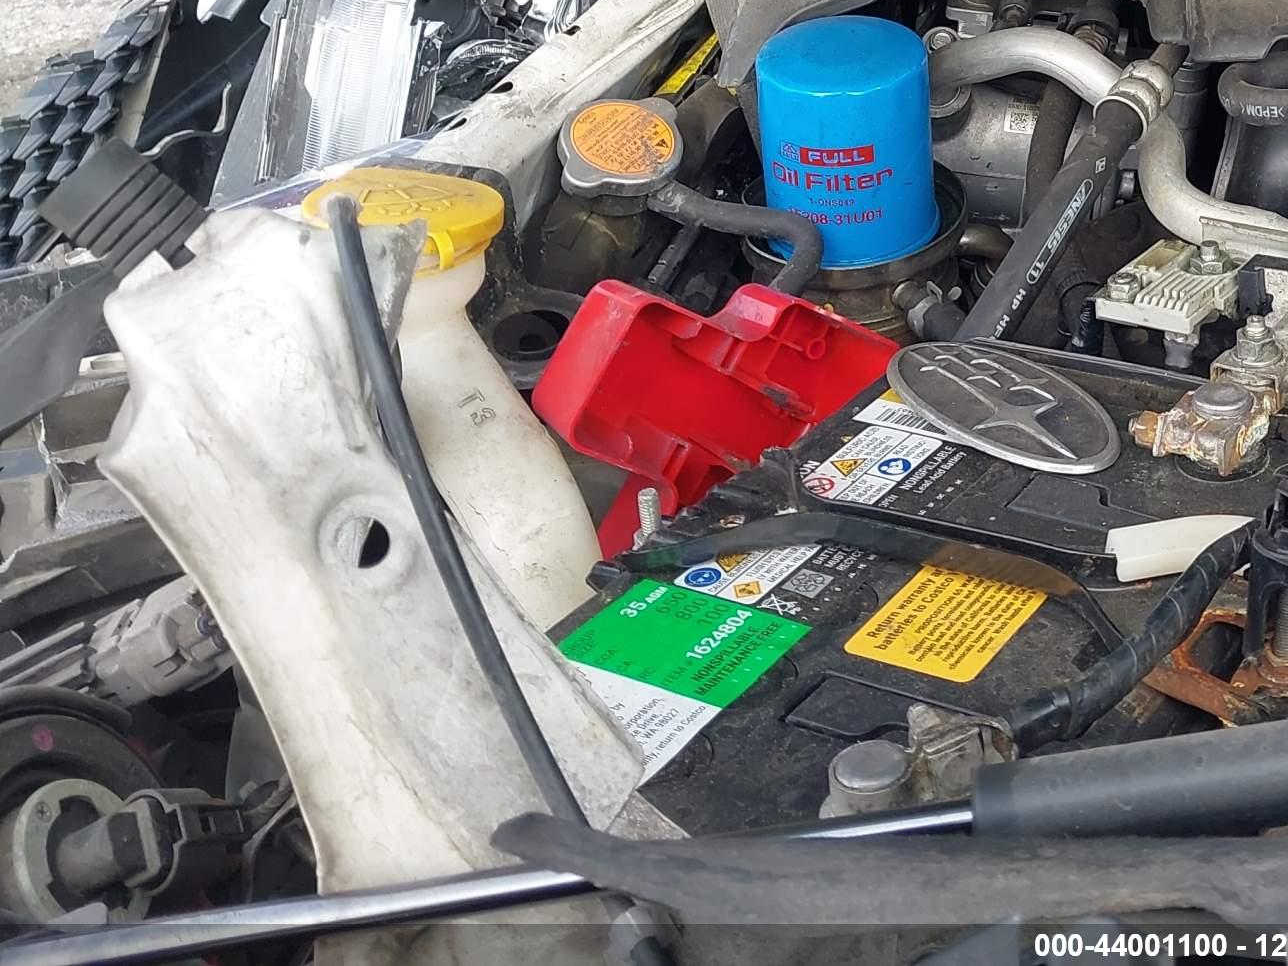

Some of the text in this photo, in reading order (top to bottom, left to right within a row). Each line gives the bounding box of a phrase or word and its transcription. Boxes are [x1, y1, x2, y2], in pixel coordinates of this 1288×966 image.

[808, 150, 864, 163] FULL
[772, 161, 893, 191] Oil Filter
[1012, 288, 1027, 310] HP
[900, 445, 956, 490] NONSPILLABLE
[913, 450, 967, 493] Lead Acid Battery
[620, 586, 668, 618] 35 AGM
[655, 592, 687, 614] 650
[675, 597, 709, 621] 800
[698, 604, 731, 627] 100
[866, 606, 901, 639] Return
[898, 576, 936, 613] warranty
[874, 613, 918, 651] batteries
[912, 601, 926, 615] to
[922, 577, 954, 604] Costco
[915, 595, 957, 635] PROPOSITION
[686, 609, 753, 659] 1624804
[690, 626, 760, 682] NONSPILLABLE
[696, 621, 782, 696] MAINTENANCE FREE
[613, 702, 625, 712] by
[624, 697, 665, 731] orporation,
[643, 731, 657, 747] WA
[654, 708, 680, 736] 98027
[657, 731, 678, 753] return
[675, 723, 685, 734] to
